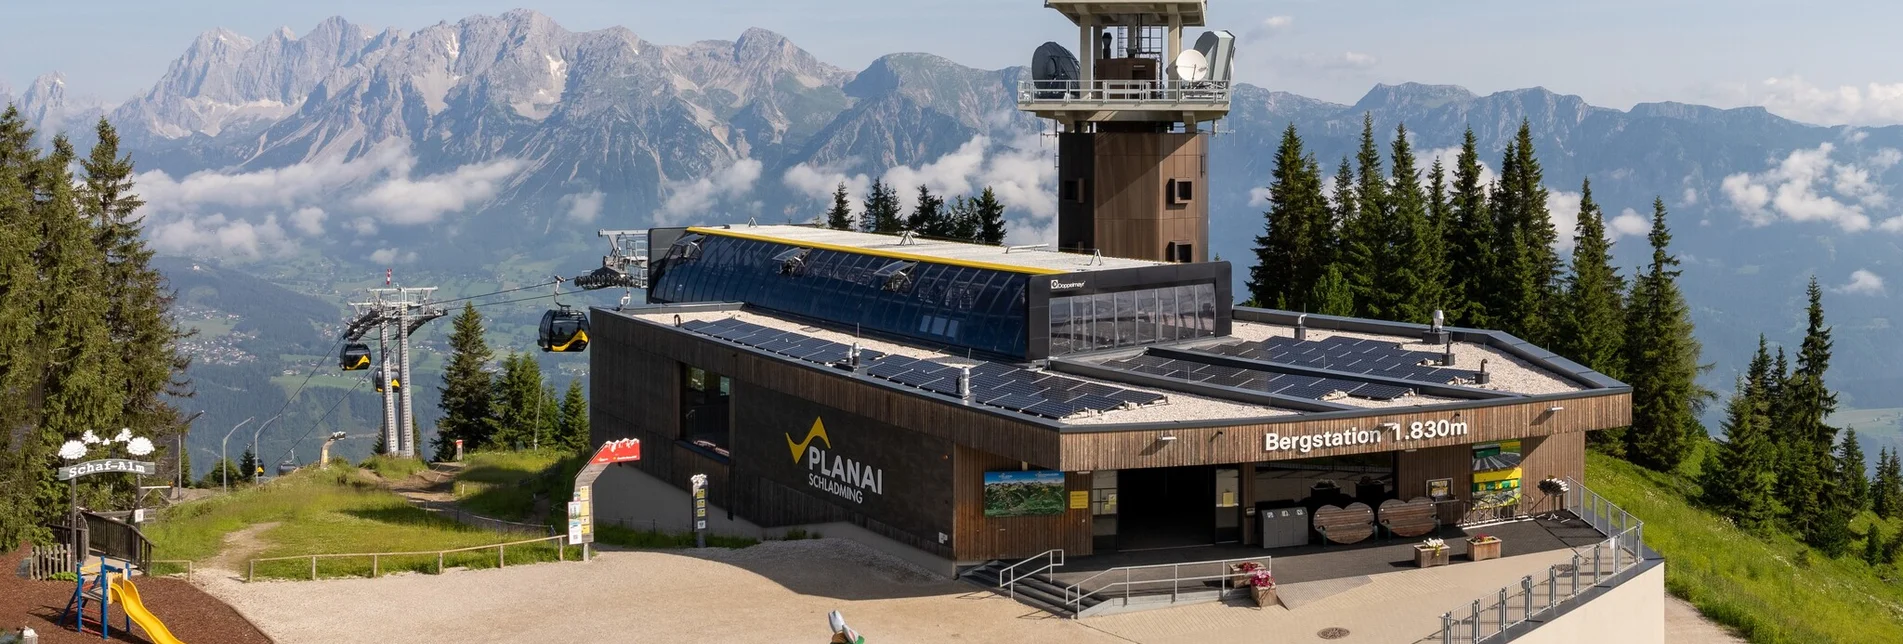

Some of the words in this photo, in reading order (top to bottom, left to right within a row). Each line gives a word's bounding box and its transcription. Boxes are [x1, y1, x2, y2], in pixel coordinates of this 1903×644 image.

[1265, 427, 1381, 453] Bergstation
[1392, 419, 1467, 441] 1.830m
[69, 461, 145, 478] Schaf-Alm
[808, 446, 882, 495] PLANAI
[808, 473, 863, 504] SCHLADMING
